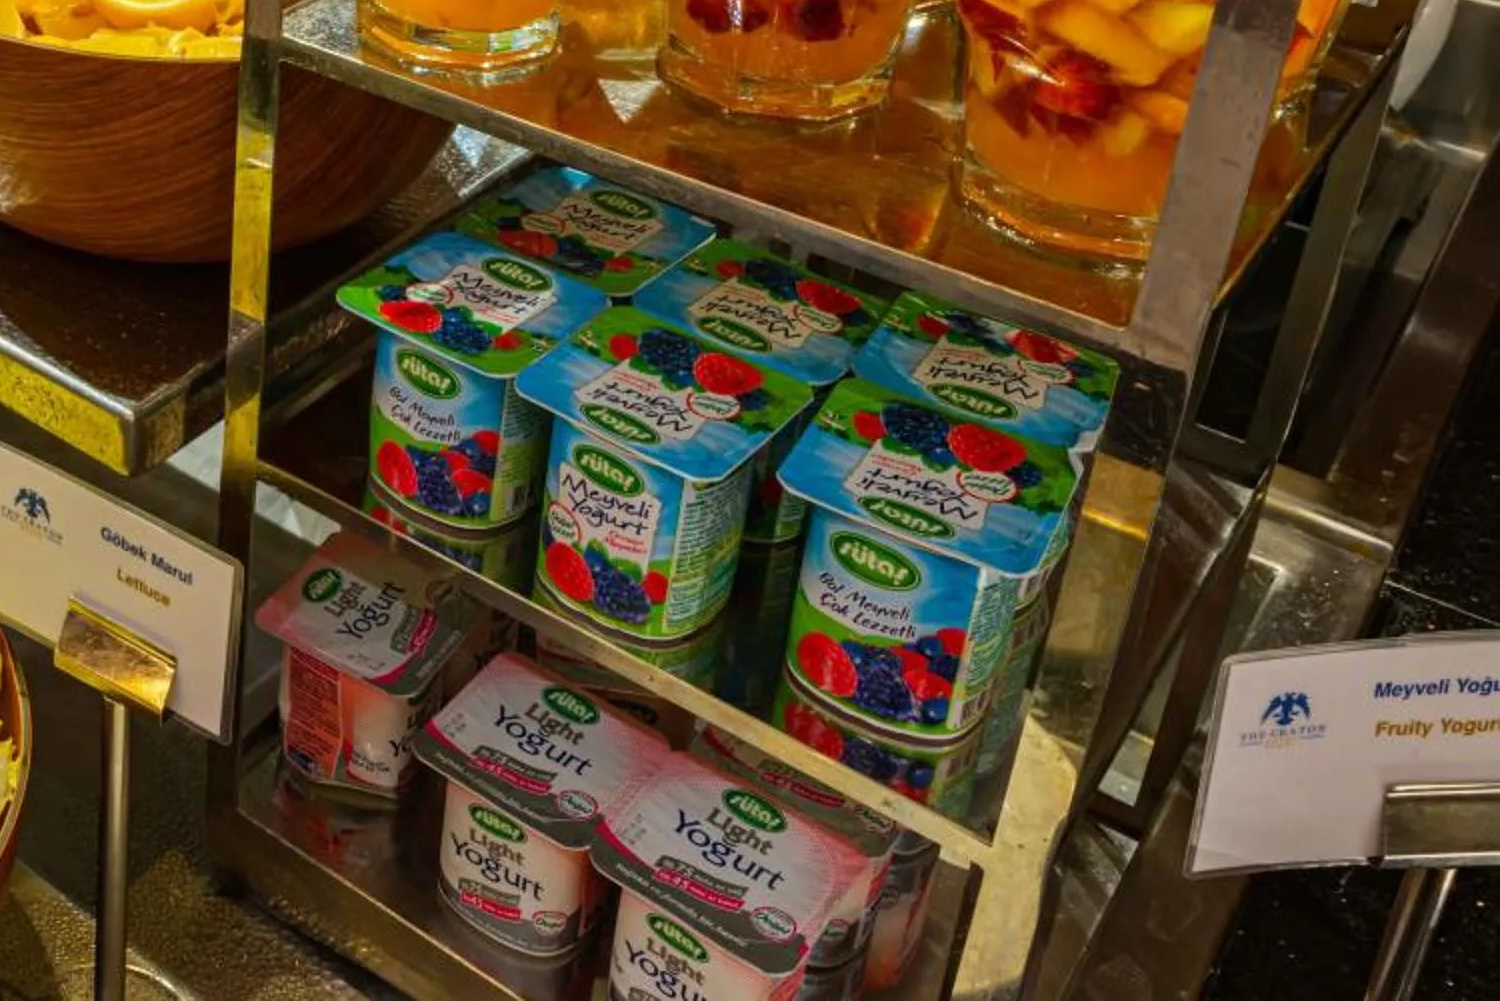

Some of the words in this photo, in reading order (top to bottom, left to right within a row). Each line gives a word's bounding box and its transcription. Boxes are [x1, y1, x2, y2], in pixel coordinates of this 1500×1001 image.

[562, 473, 654, 519] Meyveli
[100, 526, 148, 562] Göbek
[151, 552, 194, 586] Marul
[116, 567, 172, 607] Lettuce
[819, 571, 846, 595] Bol
[849, 587, 912, 621] Meyveli
[853, 611, 917, 640] Lezzetli
[1373, 677, 1451, 700] Meyveli
[524, 702, 586, 746] Light
[1374, 718, 1434, 738] Fruity
[469, 828, 525, 867] Light
[707, 806, 774, 856] Light
